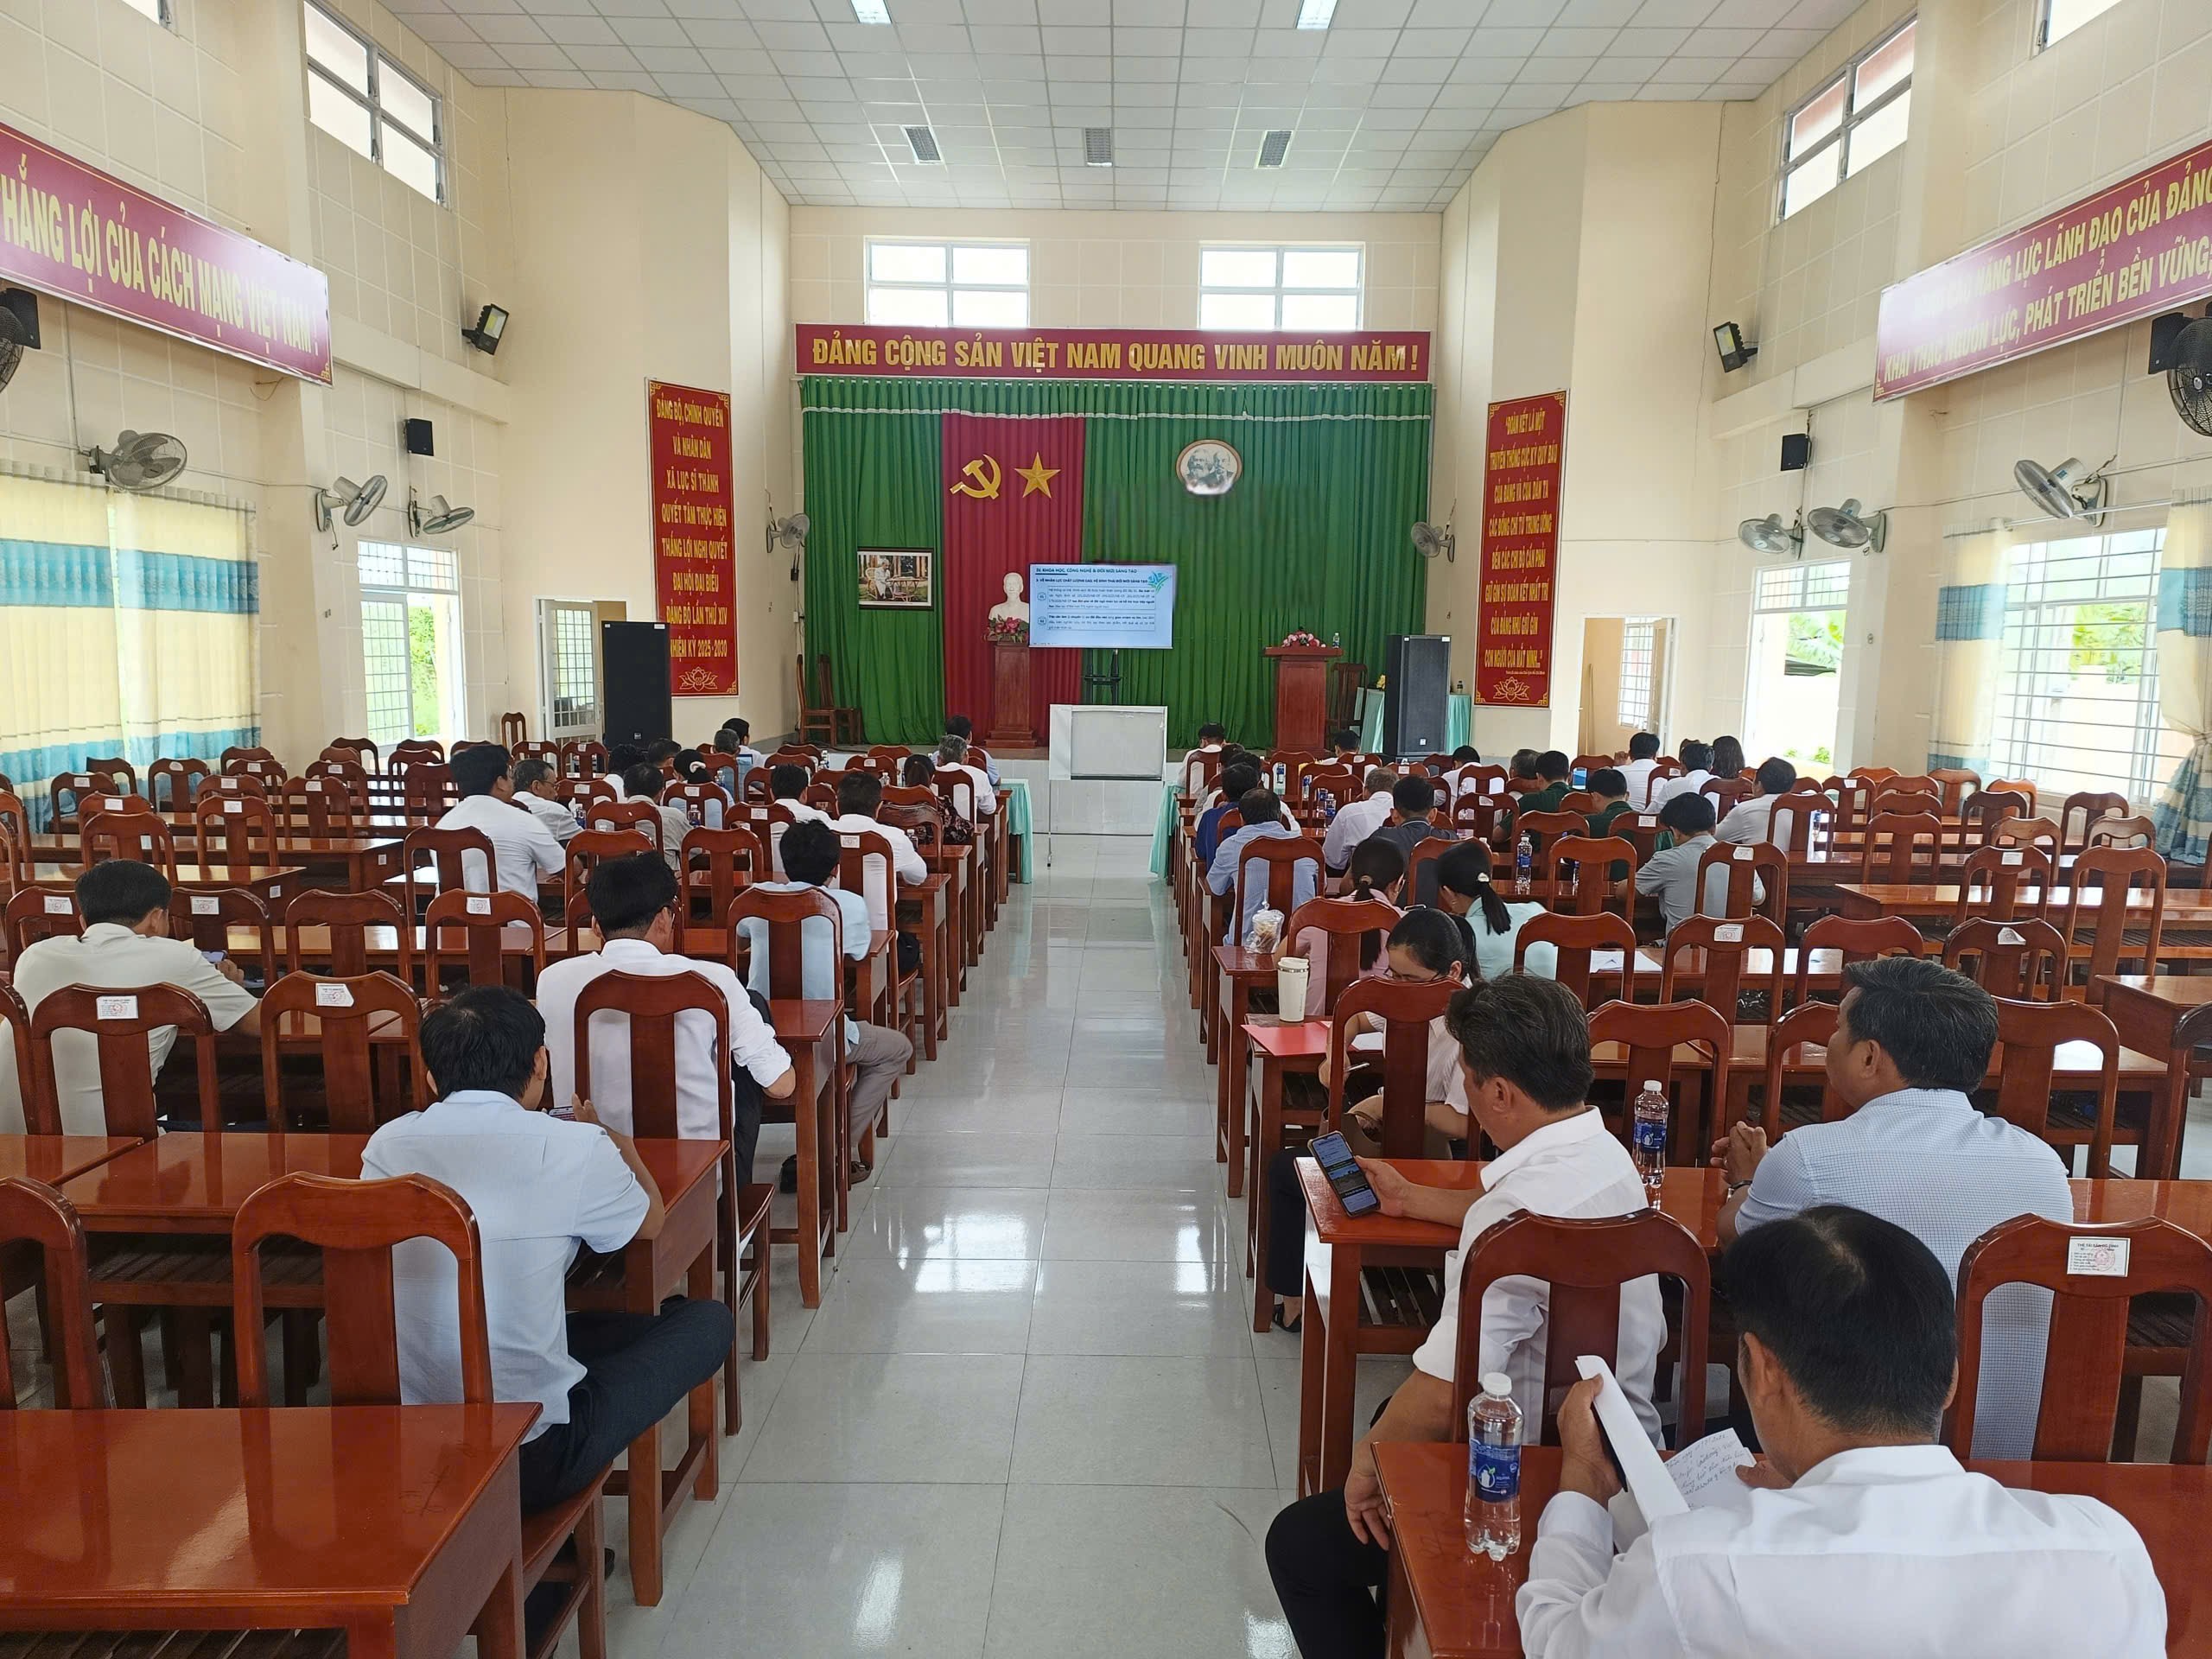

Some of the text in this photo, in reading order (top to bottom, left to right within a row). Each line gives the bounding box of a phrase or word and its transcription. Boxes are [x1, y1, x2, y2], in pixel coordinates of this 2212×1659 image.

[0, 154, 65, 263] HẮNG
[69, 199, 102, 293] LỢI
[106, 201, 145, 293] CỦA
[148, 226, 195, 312] CÁCH
[197, 257, 244, 338] MẠNG
[2015, 238, 2042, 287] LỰC
[2044, 222, 2085, 270] LÃNH
[2088, 207, 2122, 257] ĐẠO
[2126, 180, 2160, 236] CỦA
[2024, 286, 2063, 335] PHÁT
[2068, 257, 2113, 321] TRIỂN
[2117, 246, 2153, 302] BỀN
[812, 330, 877, 365] ĐẢNG
[885, 334, 946, 371] CỘNG
[955, 332, 1002, 368] SẢN
[1011, 337, 1058, 373] VIỆT
[1066, 342, 1121, 369] NAM
[1128, 342, 1205, 372] QUANG
[1214, 344, 1268, 370] VINH
[1275, 340, 1343, 371] MUÔN
[657, 392, 673, 419] ĐẢNG
[684, 399, 702, 424] CHÍNH
[672, 432, 711, 460] VÀ NHÂN DÂN
[677, 470, 690, 494] LỤC
[698, 469, 719, 493] THÀNH
[661, 498, 683, 524] QUYẾT
[683, 501, 696, 524] TÂM
[713, 505, 727, 531] HIỆN
[661, 531, 683, 557] THẮNG
[683, 535, 694, 563] LỢI
[709, 535, 728, 560] QUYẾT
[672, 572, 683, 595] ĐẠI
[695, 573, 705, 596] ĐẠI
[666, 598, 683, 624] ĐẢNG
[683, 602, 691, 629] BỘ
